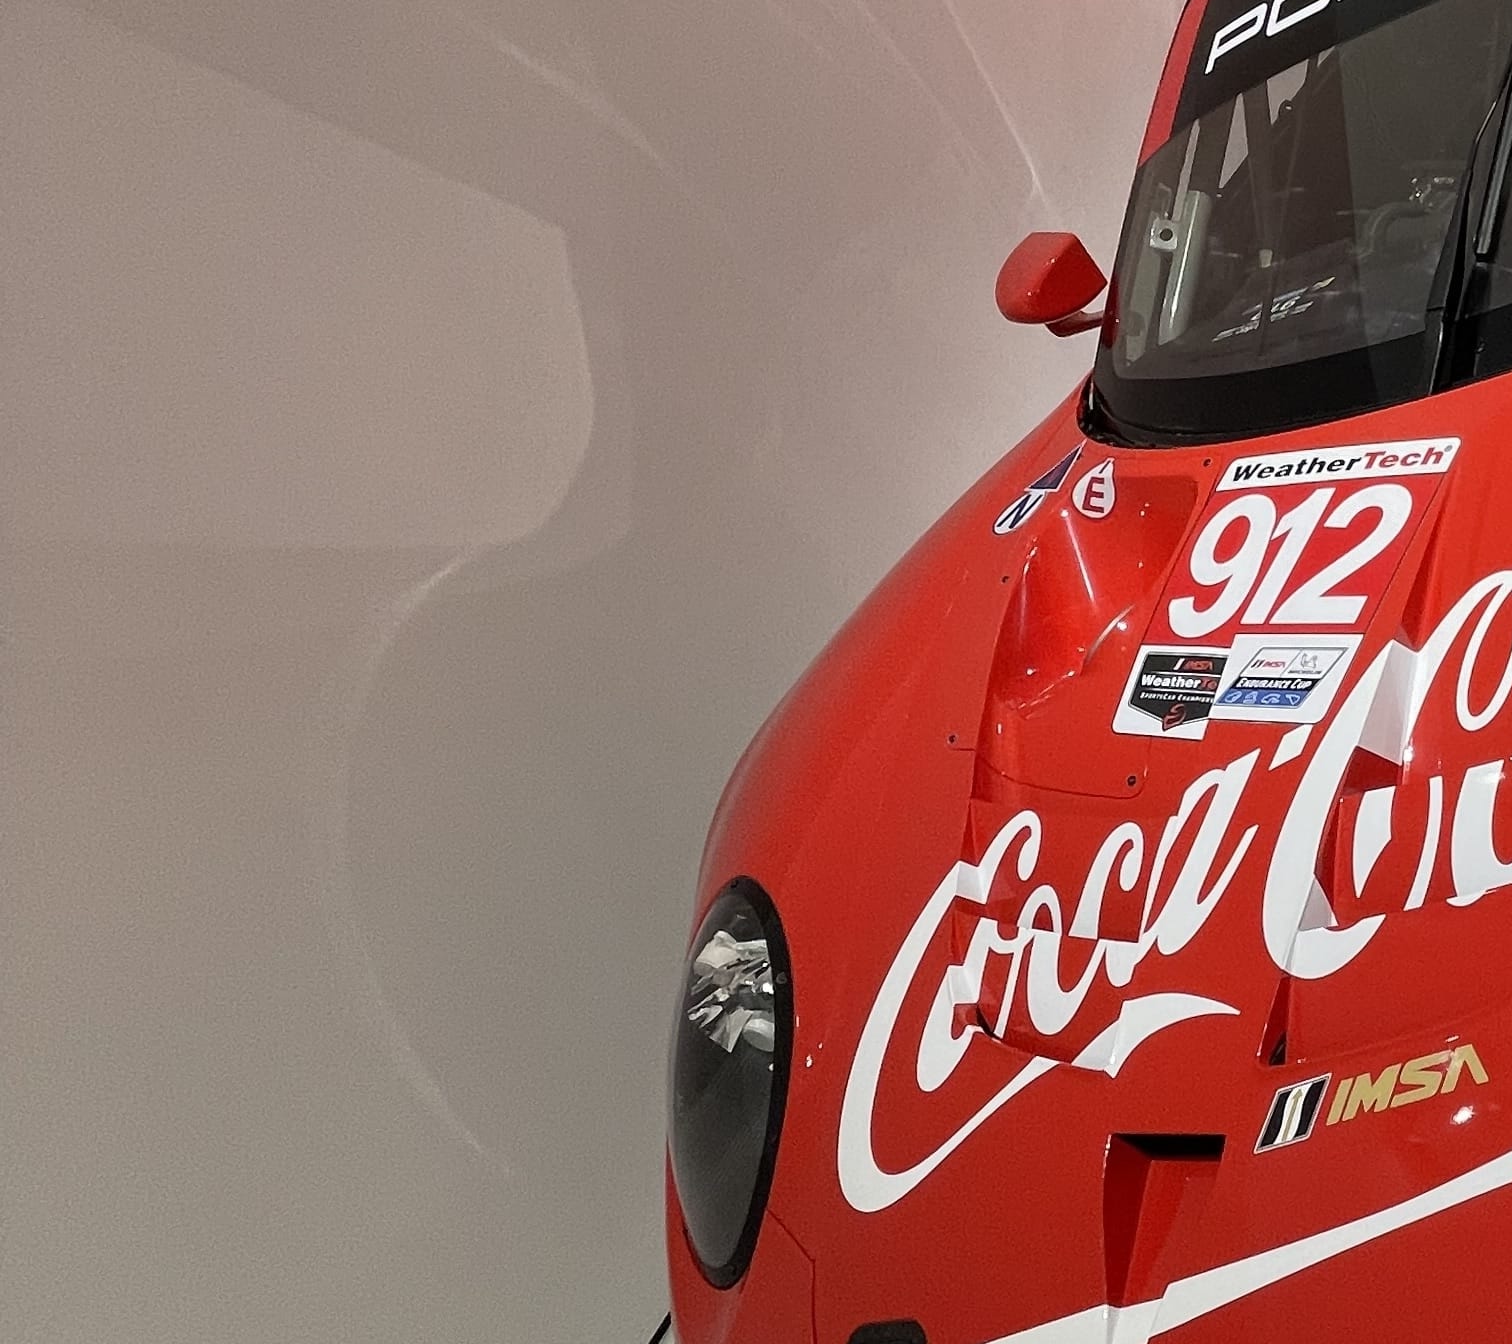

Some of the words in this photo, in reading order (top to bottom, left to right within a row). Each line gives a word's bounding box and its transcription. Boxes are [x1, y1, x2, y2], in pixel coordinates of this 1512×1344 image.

[1231, 448, 1446, 484] WeatherTech
[998, 493, 1042, 531] N
[1085, 477, 1106, 514] E
[1167, 483, 1415, 640] 912
[1140, 673, 1218, 690] WeatherTe
[1325, 1043, 1490, 1127] IMSA
